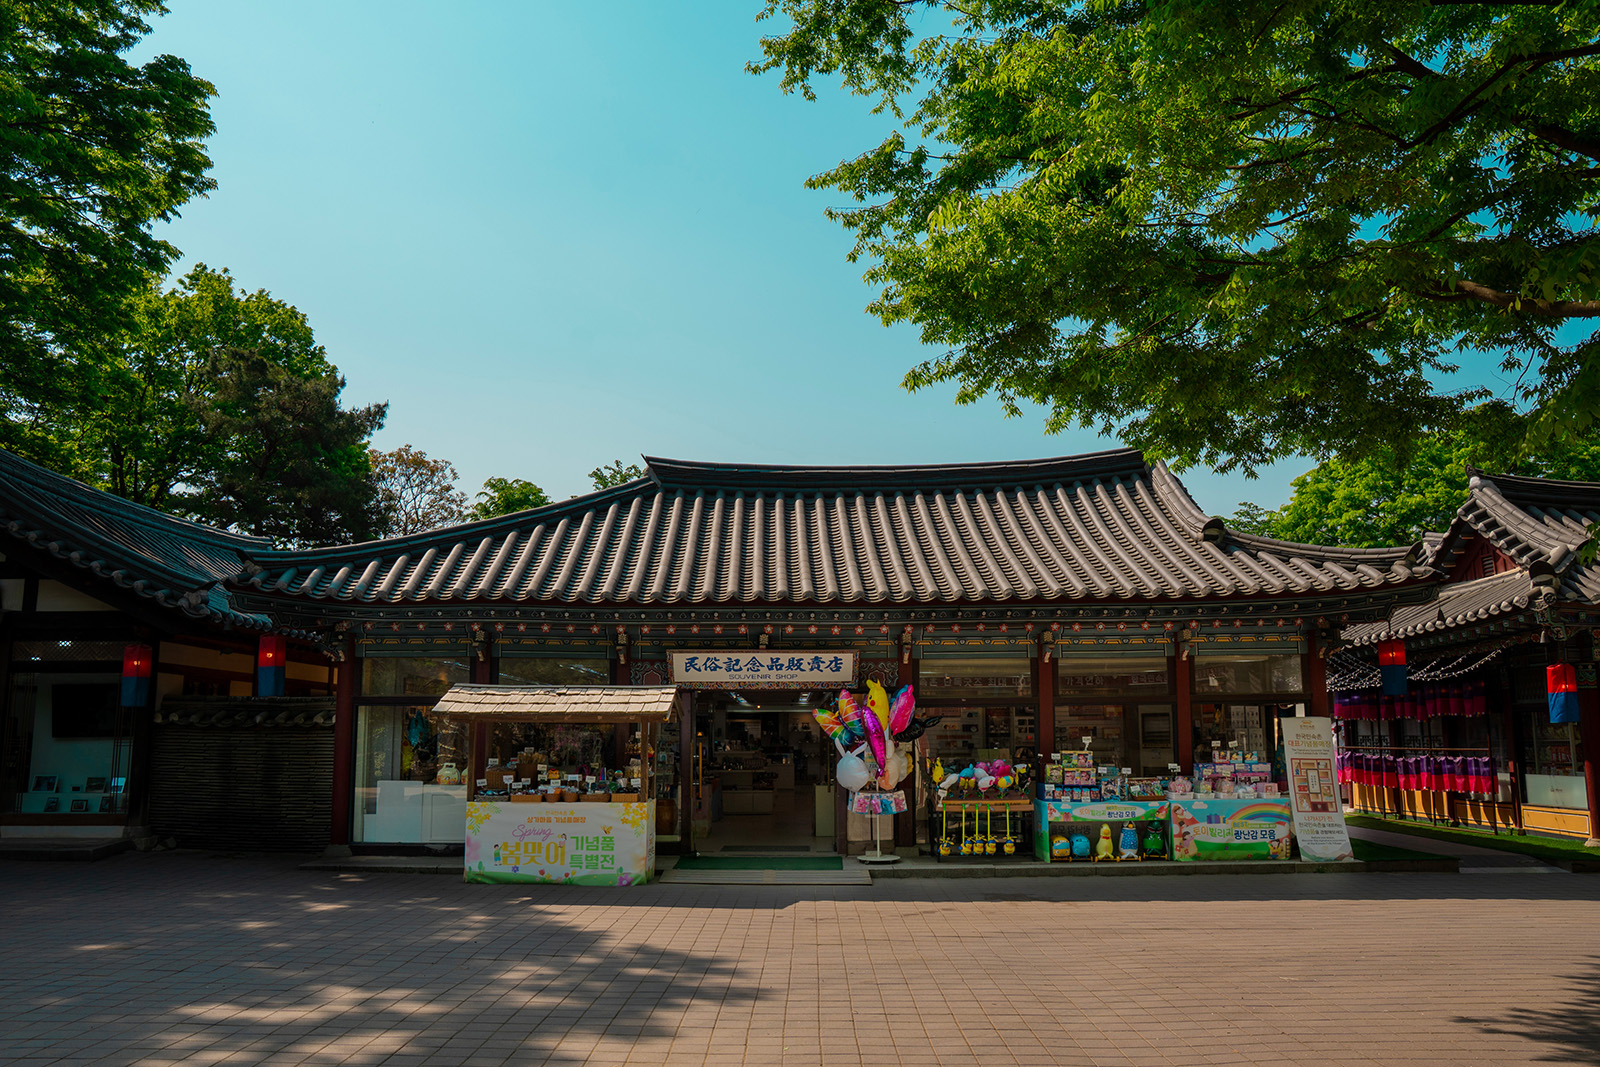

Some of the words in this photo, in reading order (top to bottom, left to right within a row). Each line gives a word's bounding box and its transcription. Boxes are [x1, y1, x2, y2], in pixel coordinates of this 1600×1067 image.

[684, 656, 844, 673] 民俗記念品販賣店
[1064, 676, 1104, 686] 가격인하
[512, 824, 554, 841] Spring
[1233, 829, 1258, 840] 장난감
[1259, 829, 1276, 840] 모음
[569, 835, 615, 852] 기념품
[501, 841, 566, 866] 봄맞이
[569, 853, 615, 870] 특별전
